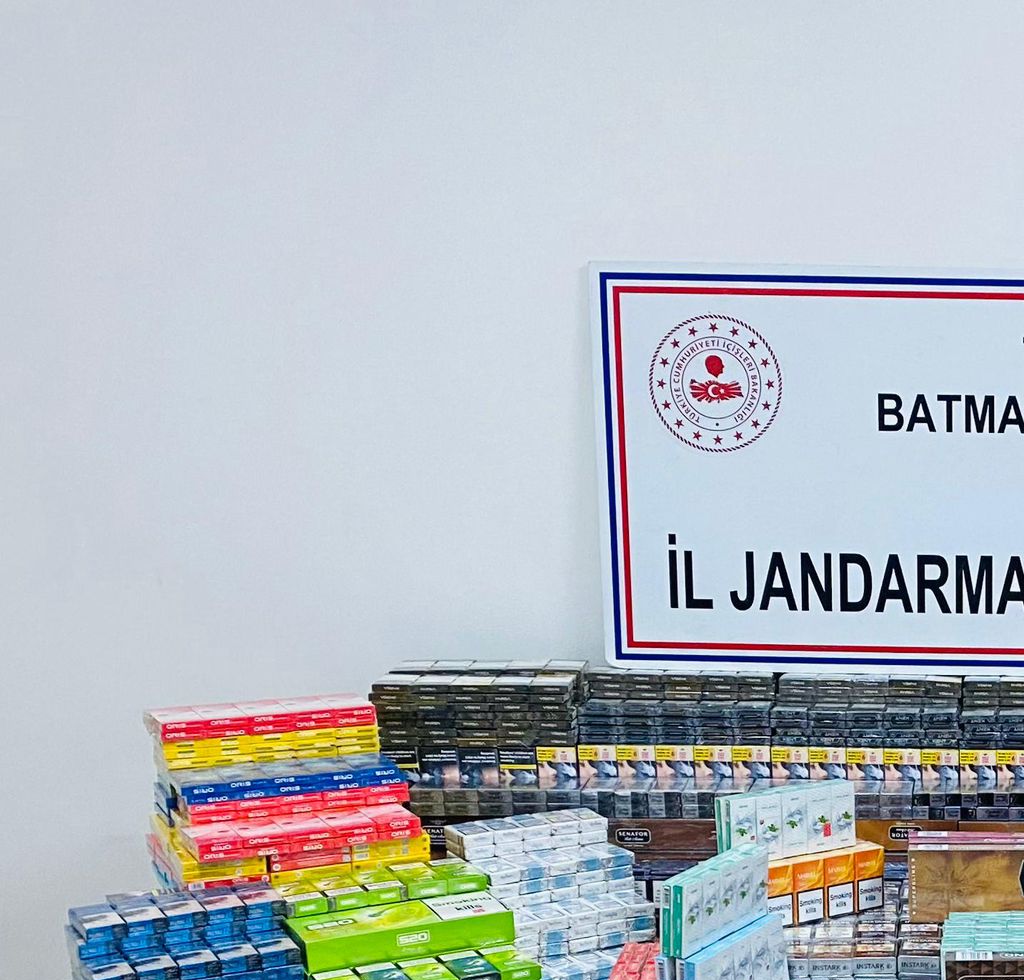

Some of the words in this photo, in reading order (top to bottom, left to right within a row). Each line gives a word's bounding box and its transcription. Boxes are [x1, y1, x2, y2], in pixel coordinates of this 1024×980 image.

[721, 340, 756, 372] İÇİŞLERİ
[672, 339, 721, 384] CUMHURİYETİ
[733, 374, 758, 423] BAKANLIĞI
[674, 386, 701, 424] TÜRKİYE
[668, 533, 714, 610] İL
[859, 885, 882, 895] Smoking
[829, 891, 852, 900] Smoking
[455, 903, 484, 911] kills
[799, 897, 822, 907] Smoking
[768, 903, 791, 913] Smoking
[812, 964, 842, 972] INSTARK
[856, 963, 885, 971] INSTARK
[901, 962, 931, 970] INSTARK
